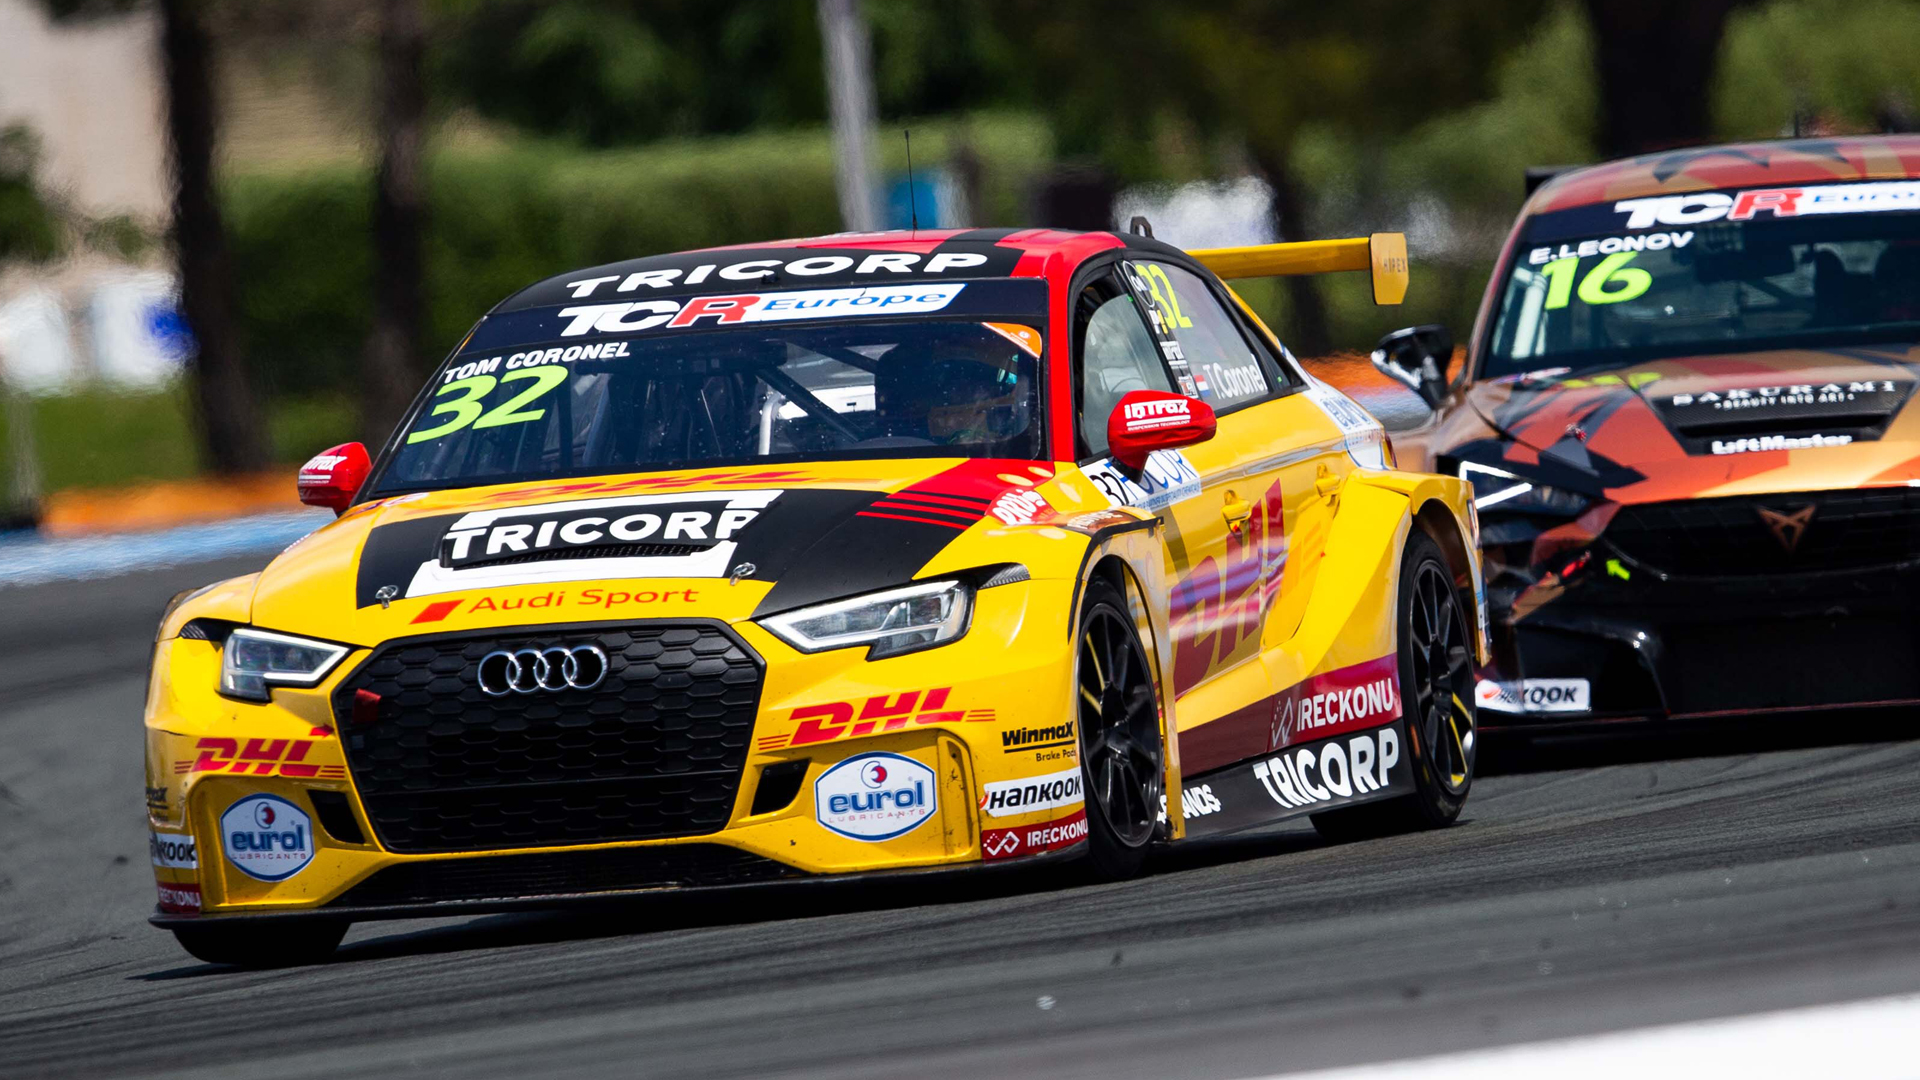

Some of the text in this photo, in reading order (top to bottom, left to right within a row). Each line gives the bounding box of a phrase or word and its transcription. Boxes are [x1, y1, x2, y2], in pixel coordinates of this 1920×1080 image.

[1614, 187, 1804, 229] TCR
[1529, 231, 1694, 266] E.LEONOV
[566, 252, 989, 299] TRICORP
[1135, 264, 1193, 329] 32
[1541, 250, 1653, 310] 16
[557, 290, 947, 337] TCR Europe
[444, 341, 630, 385] TOM CORONEL
[406, 364, 568, 446] 32
[446, 510, 761, 560] TRICORP
[468, 588, 700, 614] Audi Sport
[789, 687, 966, 746] DHL
[192, 738, 320, 777] DHL
[1036, 750, 1061, 762] Brake
[1253, 728, 1400, 809] TRICORP
[828, 808, 925, 823] LUBRICANTS
[829, 780, 924, 815] eurol
[231, 824, 305, 852] eurol
[1027, 817, 1088, 848] IRECKONU
[232, 852, 307, 860] LUBRICANTS
